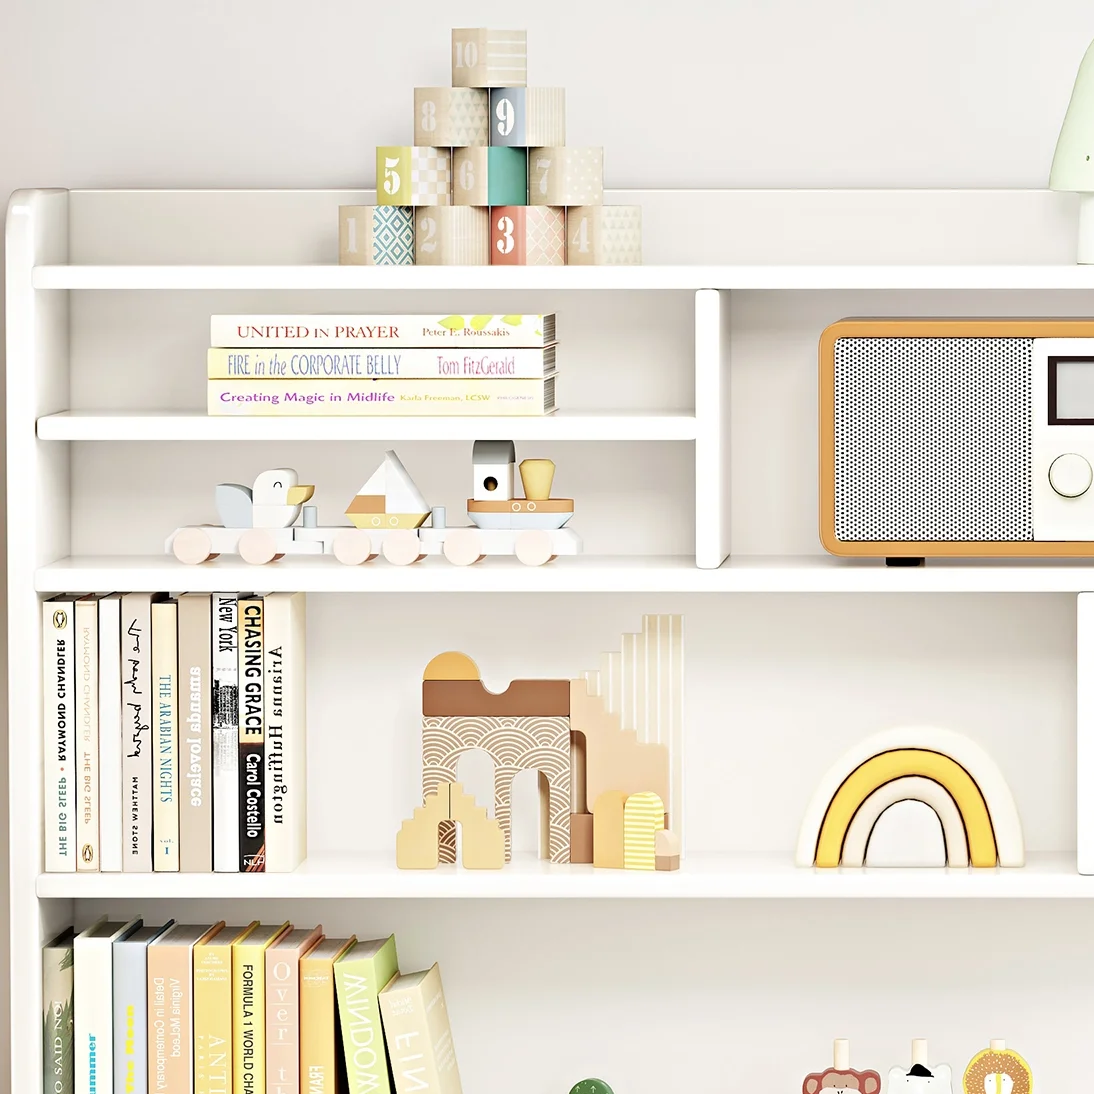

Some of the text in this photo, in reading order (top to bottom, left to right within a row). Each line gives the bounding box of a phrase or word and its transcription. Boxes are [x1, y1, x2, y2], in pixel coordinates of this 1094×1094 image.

[455, 41, 478, 68] 10
[421, 100, 437, 132] 8
[496, 98, 515, 136] 9
[383, 157, 400, 195] 5
[459, 159, 475, 191] 6
[536, 159, 552, 194] 7
[345, 217, 358, 253] 1
[420, 217, 437, 252] 2
[496, 216, 514, 254] 3
[571, 216, 590, 253] 4
[238, 326, 399, 338] UNITED IN PRAYER
[422, 327, 446, 337] Peter
[463, 327, 510, 337] Roussakis
[229, 354, 401, 375] FIRE in the CORPORATE BELLY
[437, 356, 514, 375] Tom FitzGerald
[220, 392, 394, 404] Creating Magic in Midlife
[218, 597, 238, 653] New York
[245, 605, 262, 735] CHASING GRACE
[160, 675, 172, 802] THE ARABIAN NIGHTS
[247, 754, 261, 837] Carol Costello
[243, 965, 253, 1017] FORMULA
[55, 1000, 64, 1033] NO!
[55, 1037, 64, 1075] SAID
[243, 1030, 253, 1069] WORLD
